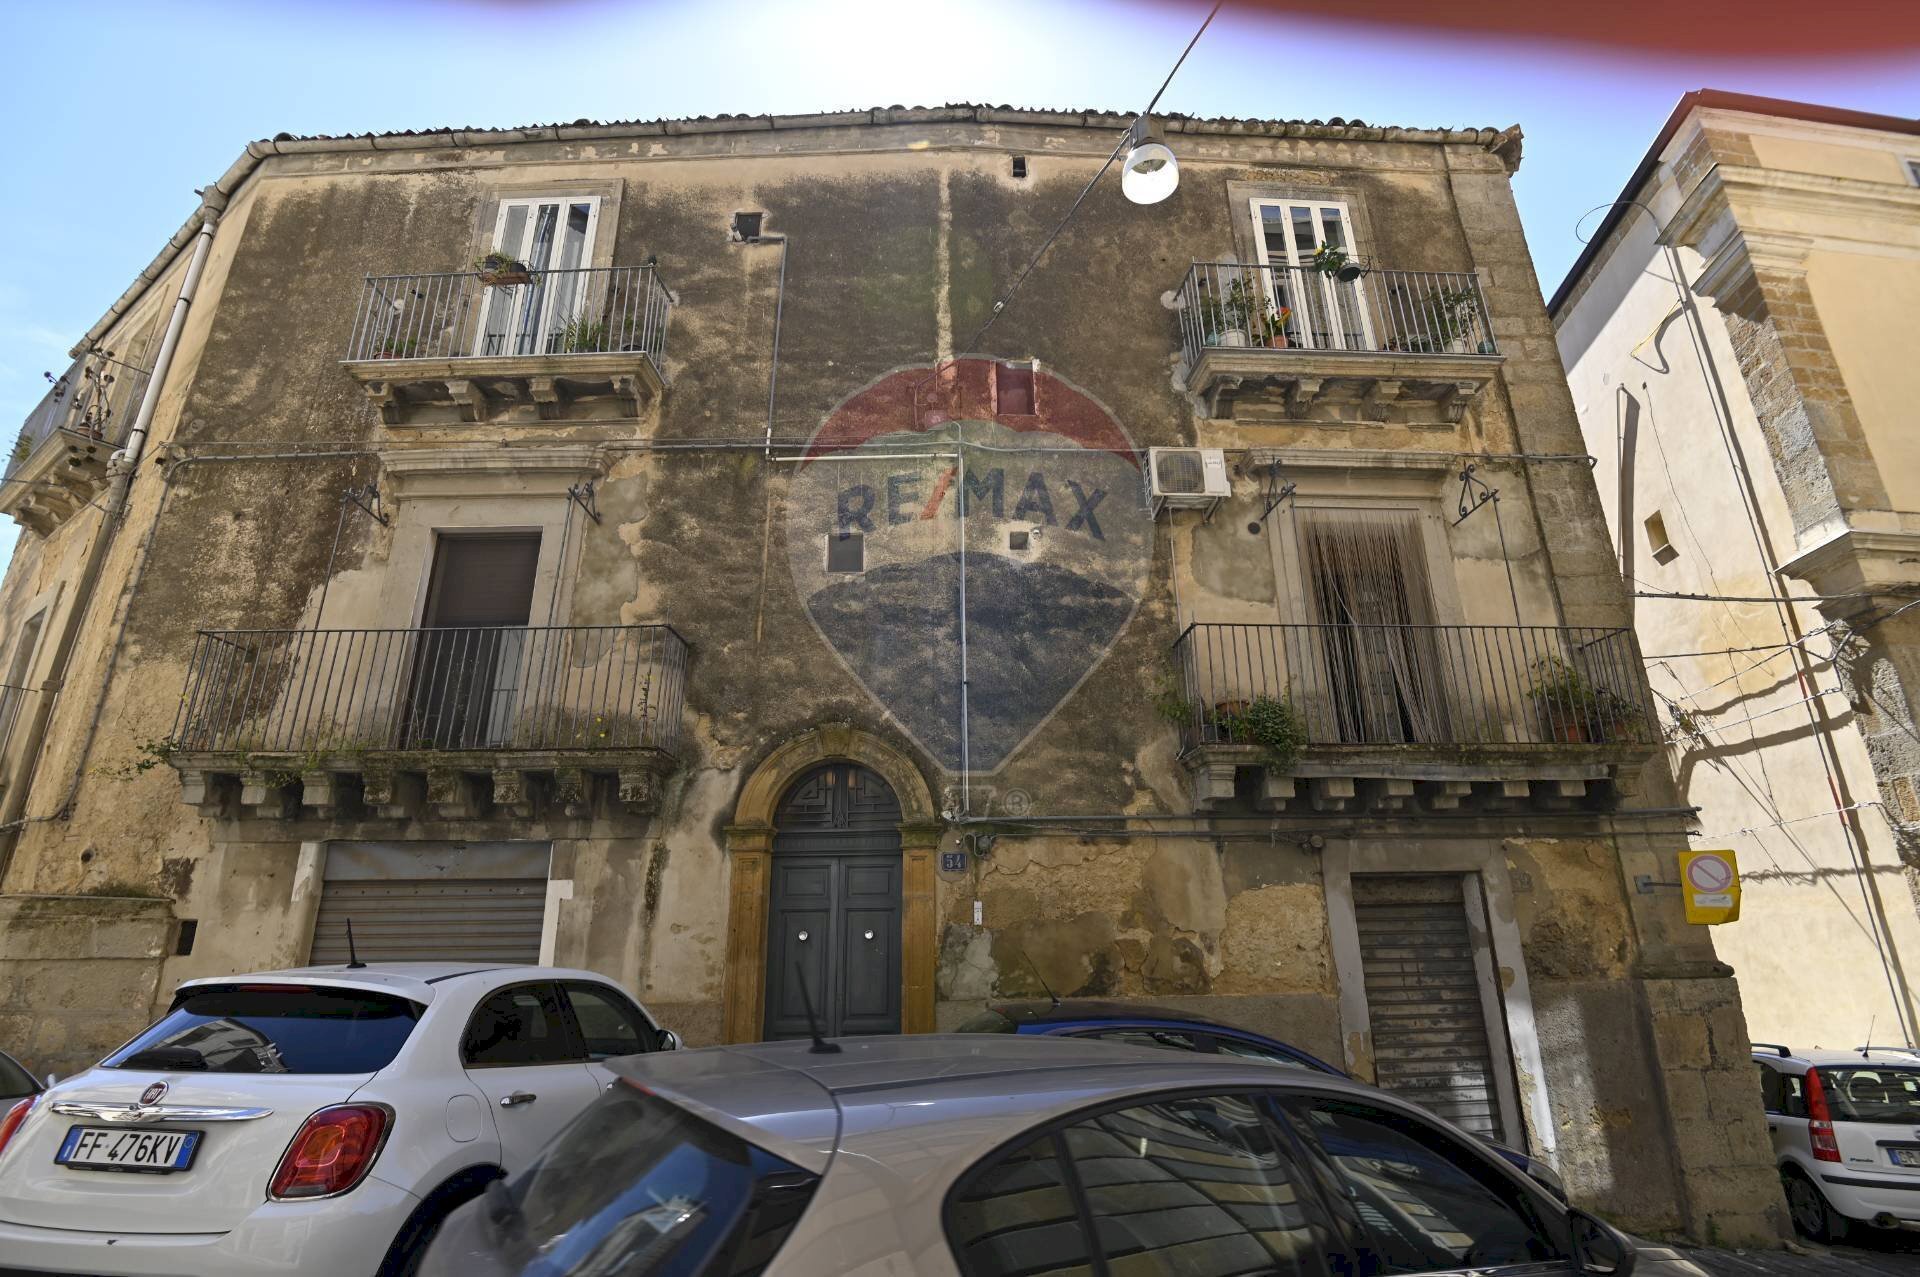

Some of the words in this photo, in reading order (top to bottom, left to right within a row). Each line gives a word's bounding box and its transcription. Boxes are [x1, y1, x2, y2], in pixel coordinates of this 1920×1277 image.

[946, 854, 961, 868] 54
[143, 1087, 162, 1100] FIAT
[73, 1131, 108, 1160] FF
[107, 1133, 181, 1164] 476KV
